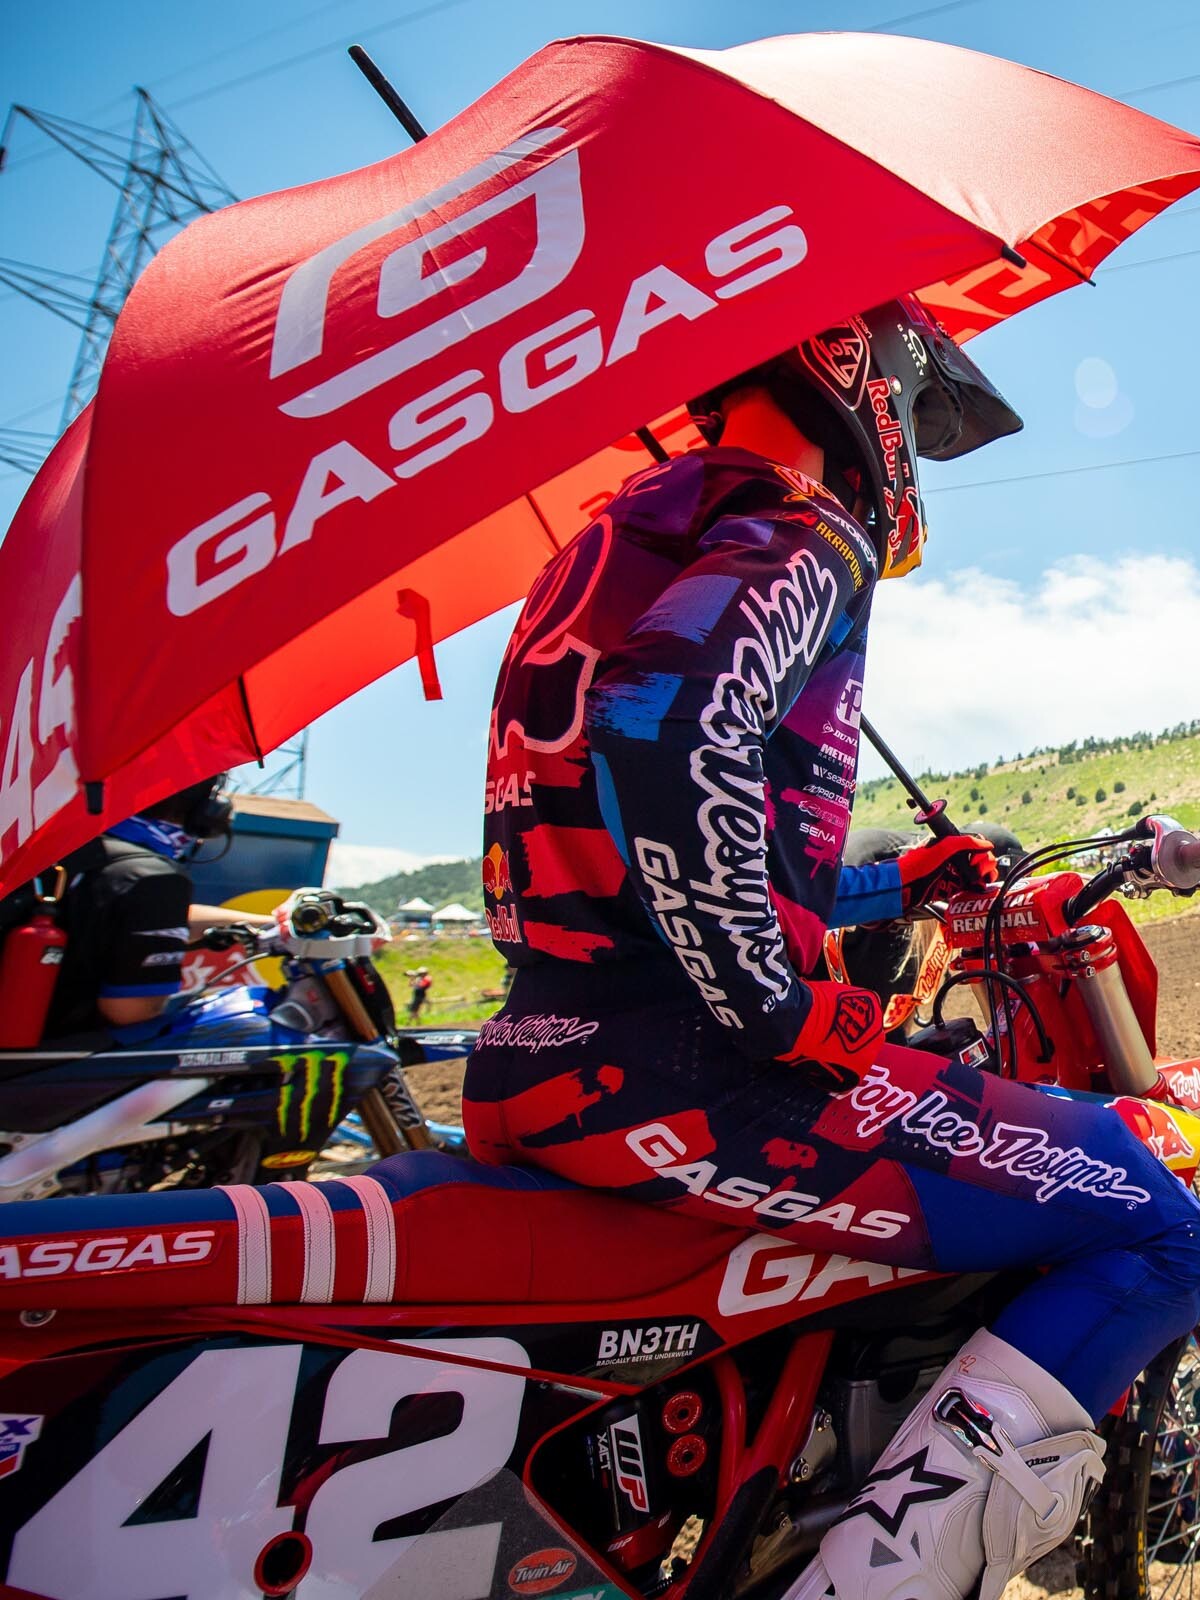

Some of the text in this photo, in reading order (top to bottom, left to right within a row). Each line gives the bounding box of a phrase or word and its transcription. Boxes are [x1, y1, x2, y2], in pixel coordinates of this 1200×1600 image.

[896, 323, 925, 376] OAKLEY
[167, 205, 808, 617] GASGAS
[833, 729, 858, 748] DUNL
[820, 743, 856, 768] METHO
[818, 787, 834, 800] PRO
[799, 822, 836, 845] SENA
[633, 836, 744, 1029] GASGAS
[952, 910, 1040, 933] RENHAL
[1169, 1070, 1199, 1103] Troy
[906, 1090, 984, 1157] Lee
[978, 1121, 1151, 1203] Designs
[625, 1122, 910, 1239] GASGAS
[598, 1323, 700, 1359] BN3TH
[596, 1350, 693, 1367] RADICALLY BETTER UNDERWEAR
[958, 1354, 977, 1373] 42
[5, 1336, 532, 1600] 42
[596, 1432, 611, 1471] XACT
[515, 1560, 574, 1583] Twin Air
